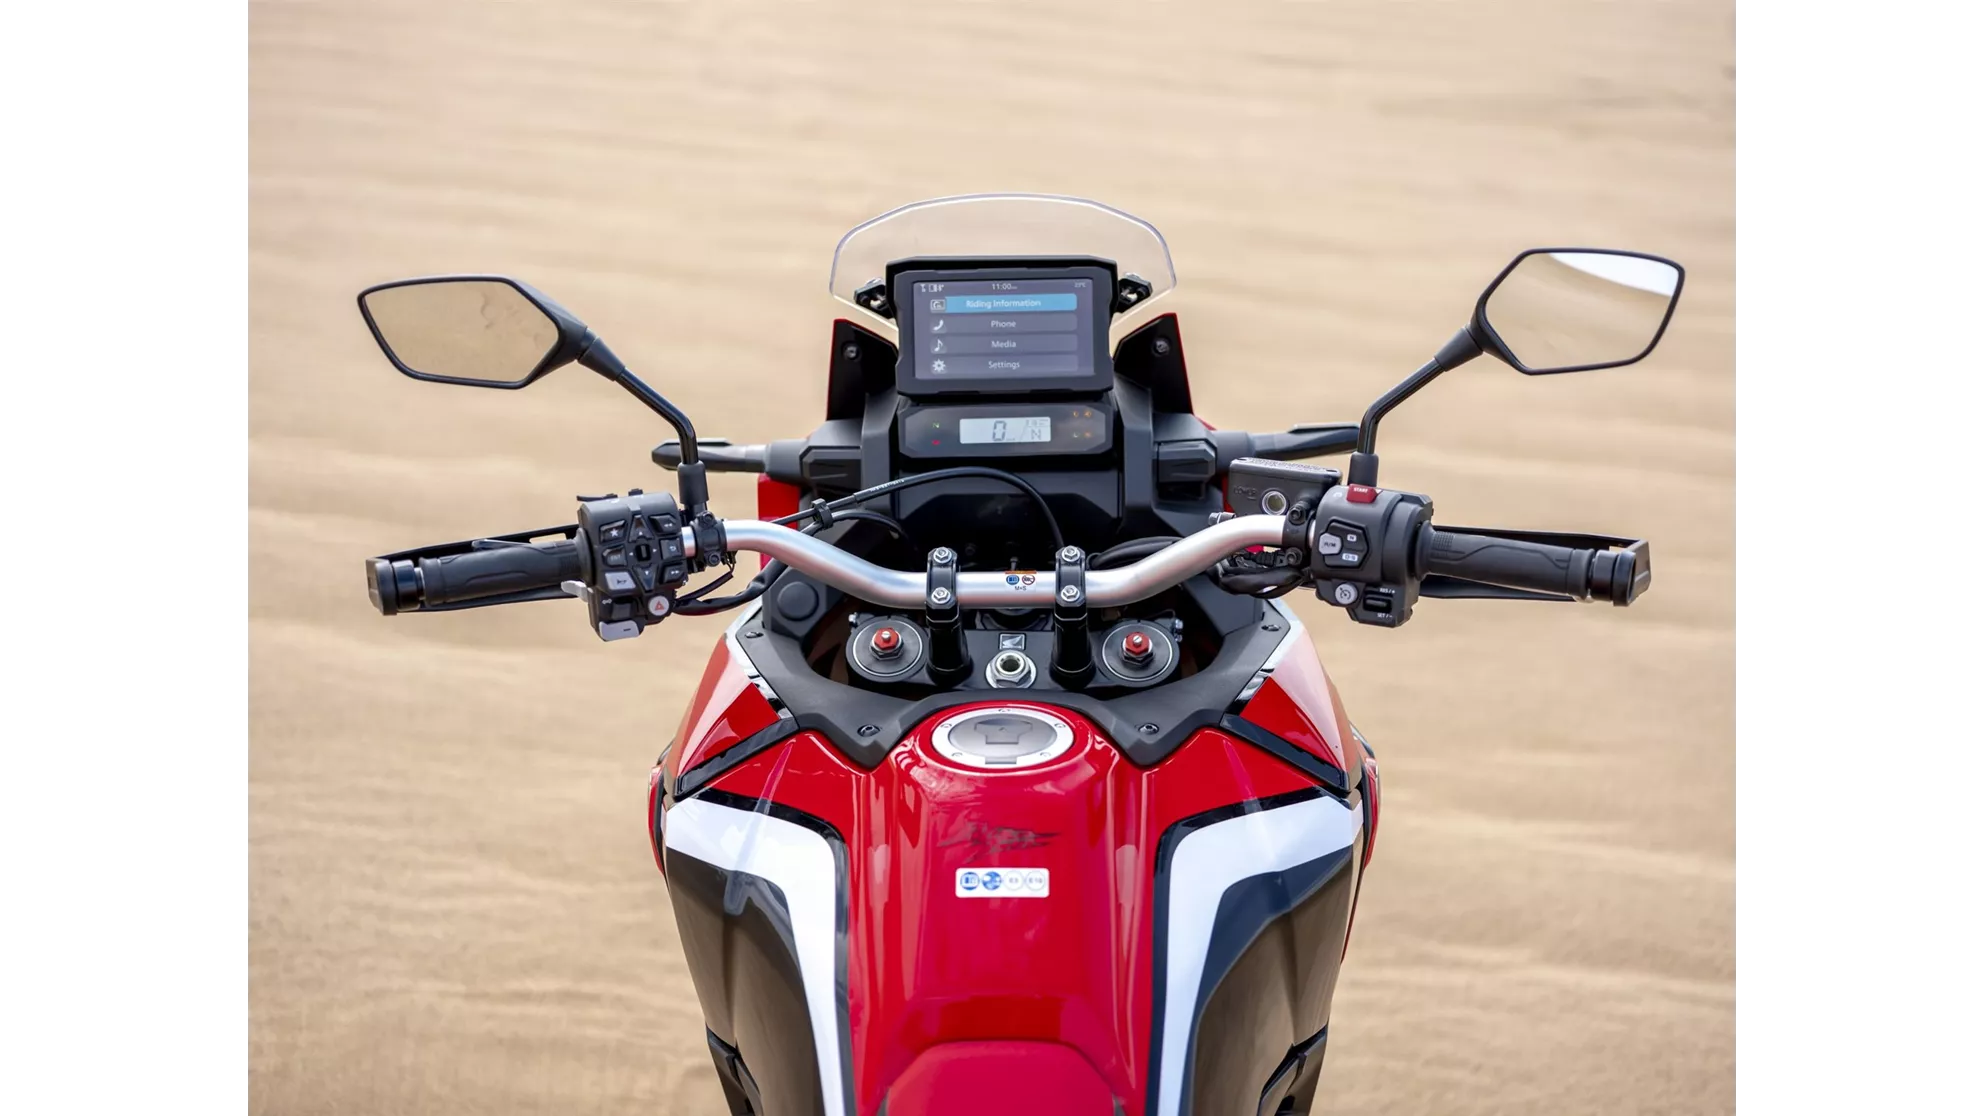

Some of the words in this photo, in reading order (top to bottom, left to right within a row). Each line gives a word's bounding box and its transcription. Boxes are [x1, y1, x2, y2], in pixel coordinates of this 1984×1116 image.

[966, 300, 992, 309] Riding
[993, 299, 1042, 308] Information
[990, 320, 1017, 328] Phone
[991, 340, 1017, 348] Media
[988, 360, 1021, 370] Settings
[1031, 429, 1041, 440] N
